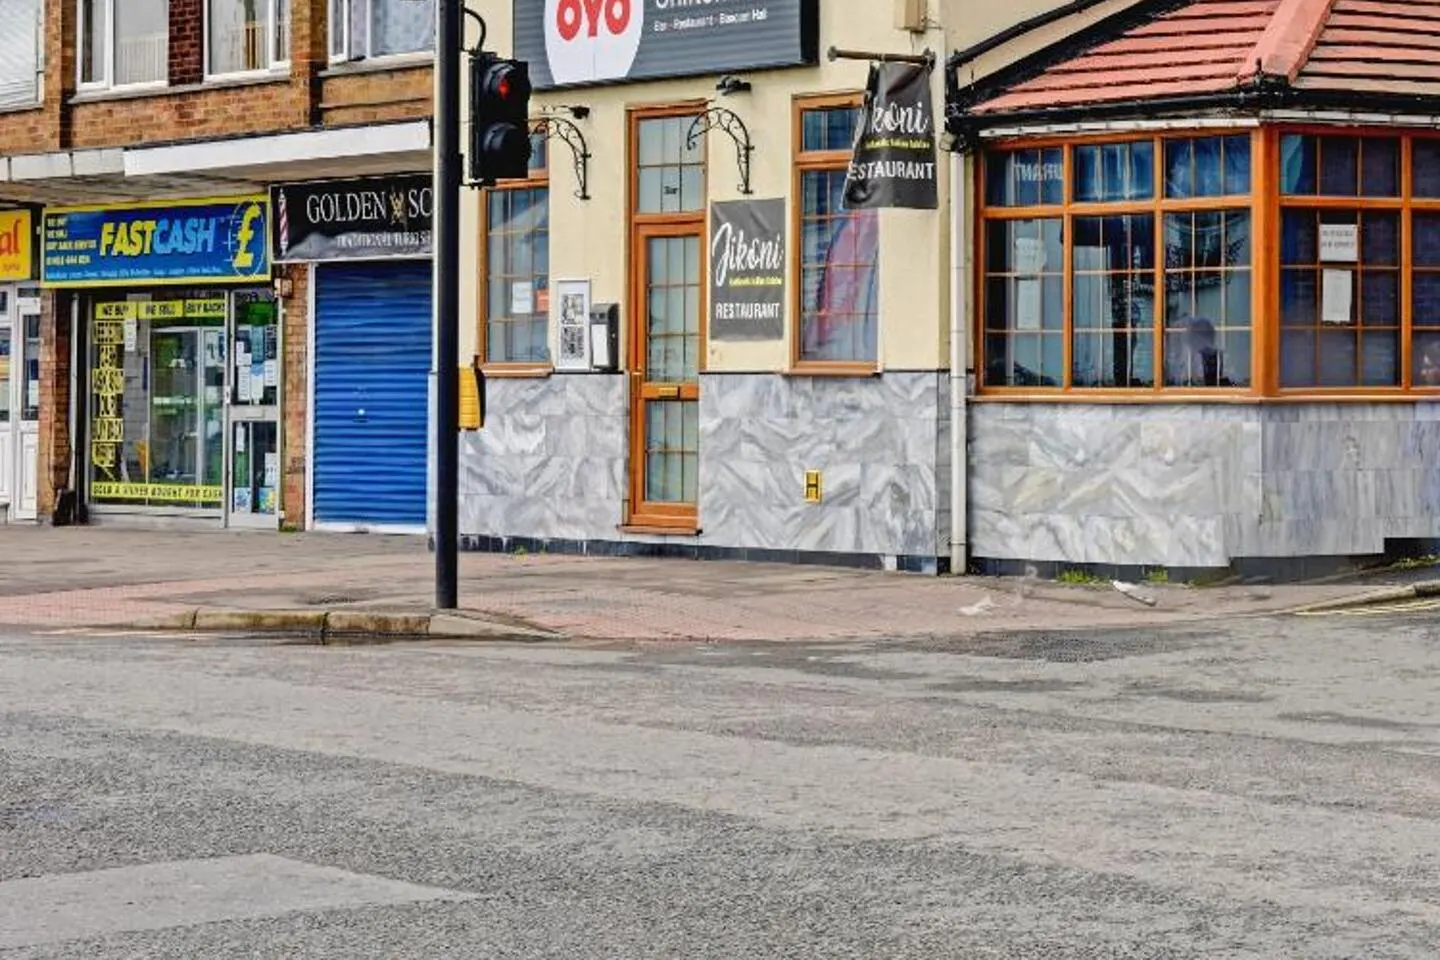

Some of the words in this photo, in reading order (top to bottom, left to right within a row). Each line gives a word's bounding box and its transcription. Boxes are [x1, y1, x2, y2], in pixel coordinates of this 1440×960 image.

[848, 161, 934, 180] ESTAURANT
[306, 191, 387, 224] GOLDEN
[408, 187, 433, 218] SC
[711, 222, 784, 288] Jikoni
[715, 302, 781, 320] RESTAURANT
